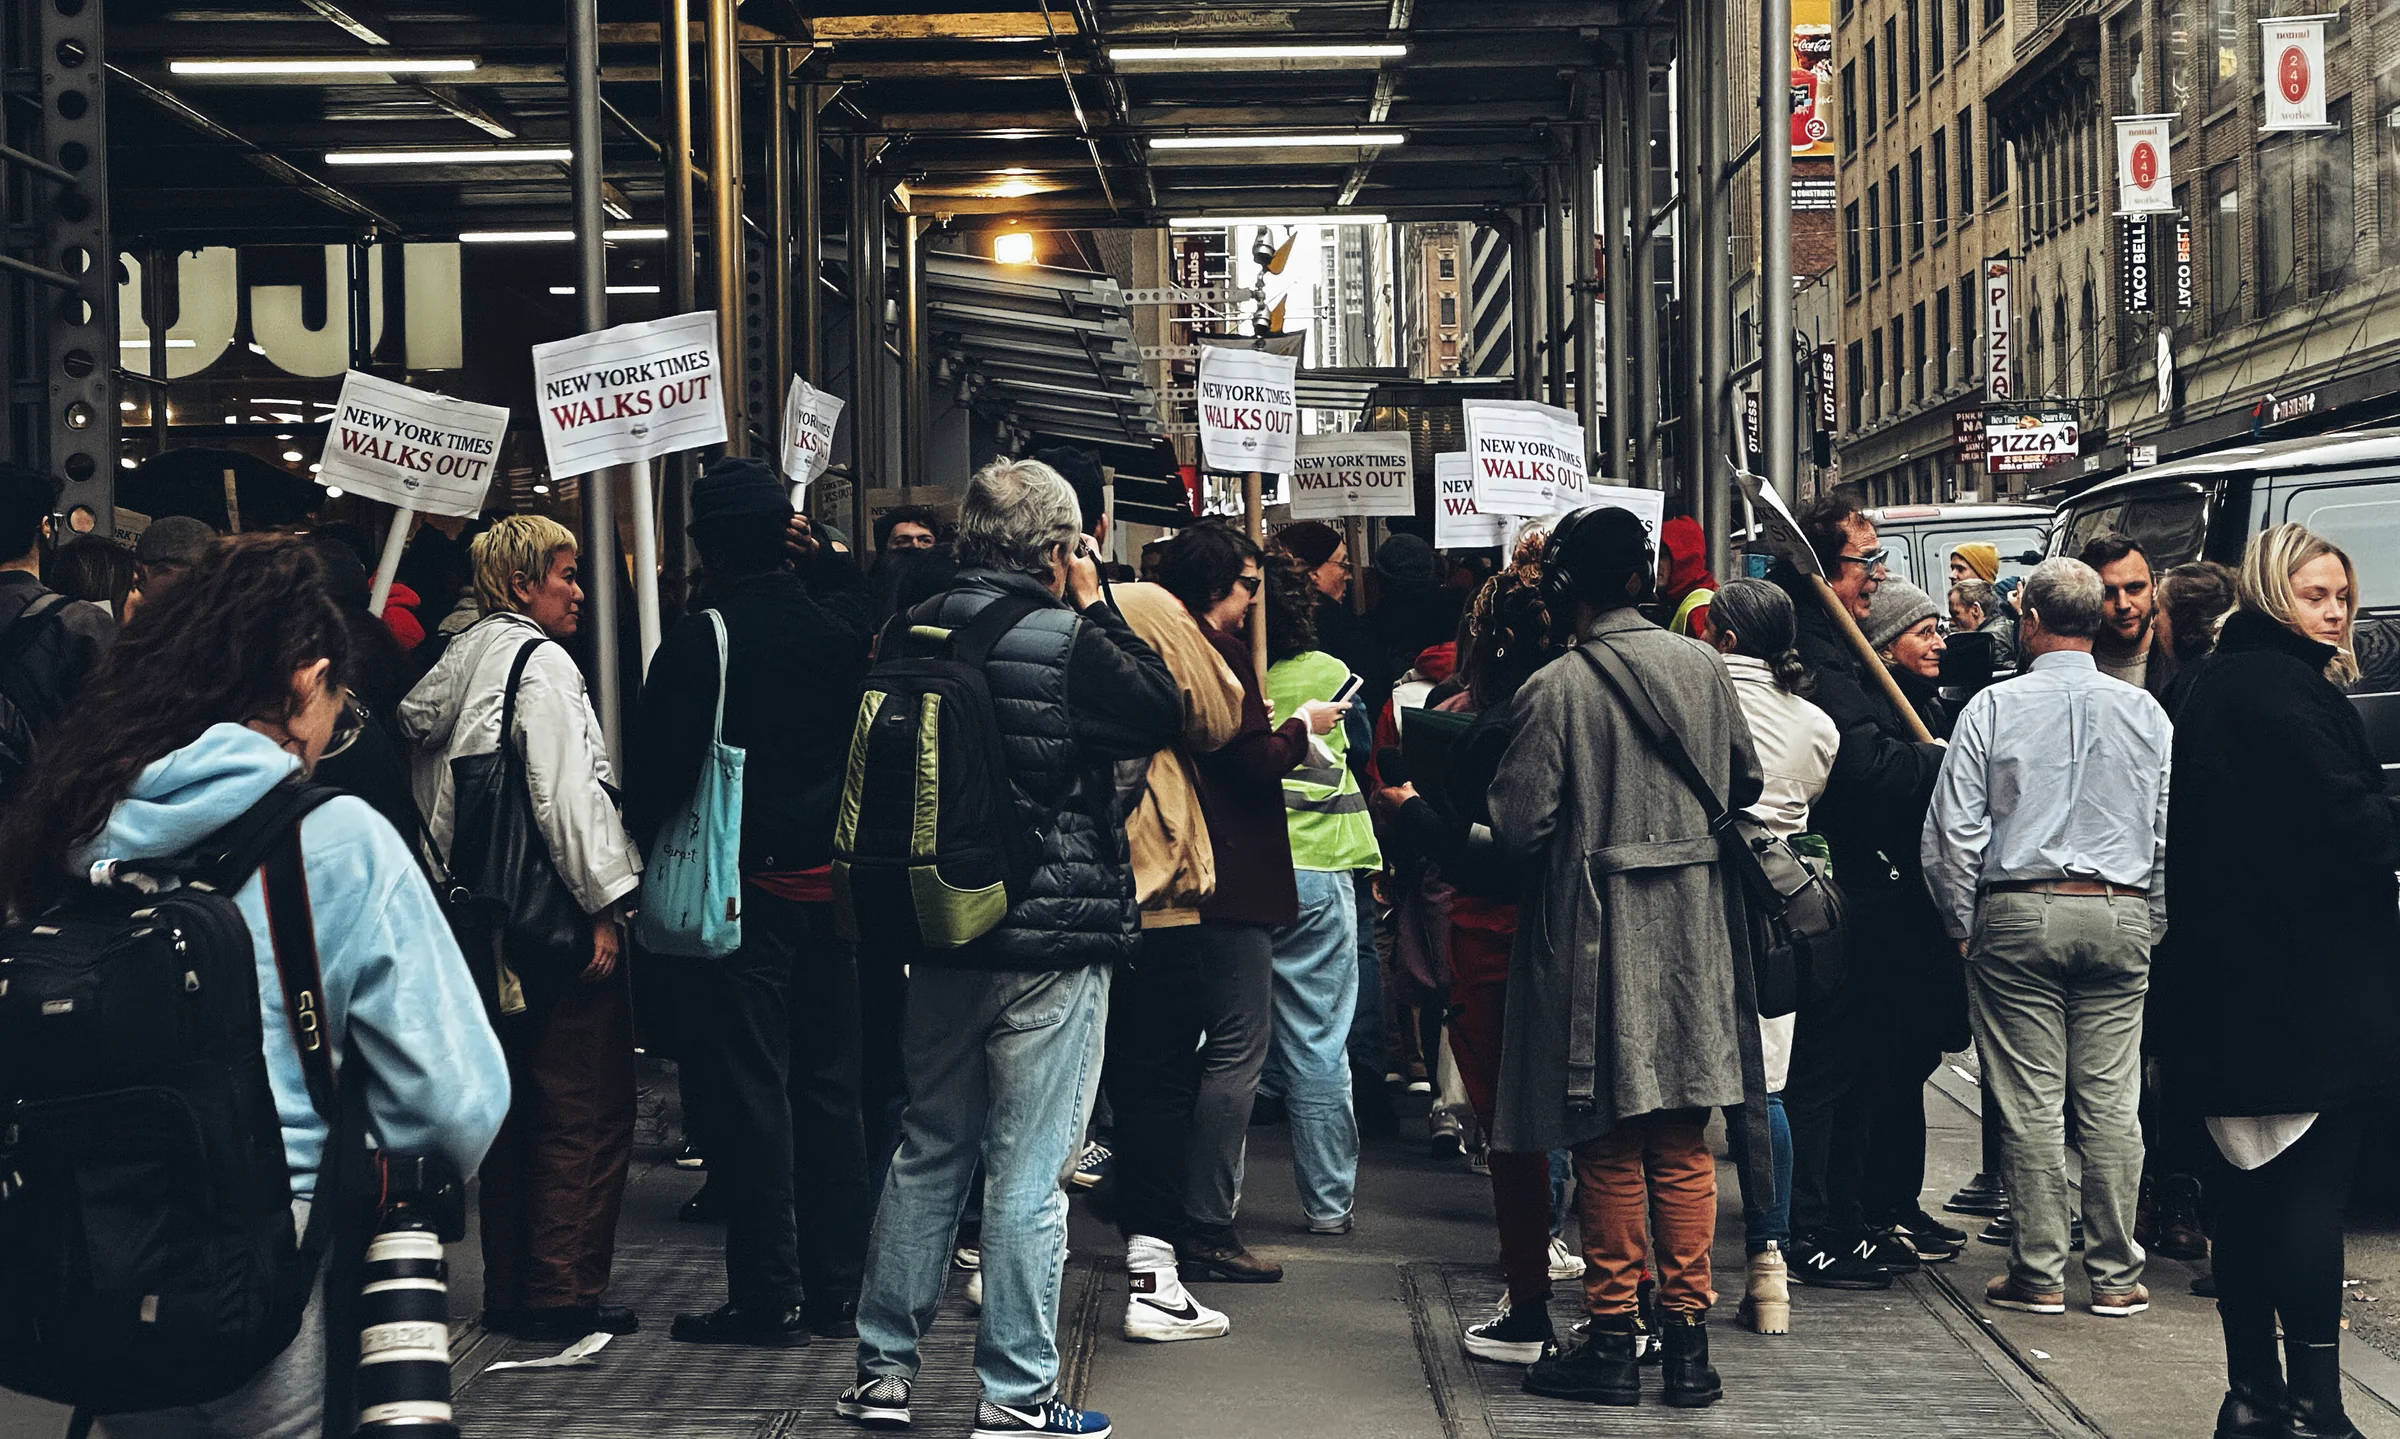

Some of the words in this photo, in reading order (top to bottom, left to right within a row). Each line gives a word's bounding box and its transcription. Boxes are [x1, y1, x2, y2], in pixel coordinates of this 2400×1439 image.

[2132, 224, 2146, 264] BELL
[2133, 265, 2147, 309] TACO
[1991, 288, 2009, 394] PIZZA
[546, 373, 592, 400] NEW
[595, 363, 654, 389] YORK
[654, 350, 710, 377] TIMES
[1202, 381, 1223, 399] NEW
[1223, 385, 1264, 402] YORK
[1266, 388, 1292, 406] TIMES
[1823, 352, 1835, 422] LOT-LESS
[550, 389, 653, 431] WALKS
[658, 374, 711, 409] OUT
[1204, 404, 1262, 431] WALKS
[1265, 411, 1293, 434] OUT
[343, 406, 392, 431] NEW
[394, 419, 446, 447] YORK
[447, 433, 494, 455] TIMES
[1988, 433, 2056, 453] PIZZA
[341, 427, 434, 473] WALKS
[436, 455, 488, 481] OUT
[1294, 456, 1326, 470] NEW
[1327, 455, 1365, 468] YORK
[1365, 455, 1406, 468] TIMES
[1480, 438, 1515, 453] NEW
[1518, 441, 1555, 459] YORK
[1555, 447, 1582, 469] TIMES
[1296, 471, 1362, 490] WALKS
[1365, 471, 1406, 488] OUT
[1481, 457, 1555, 483] WALKS
[1558, 466, 1584, 493] OUT
